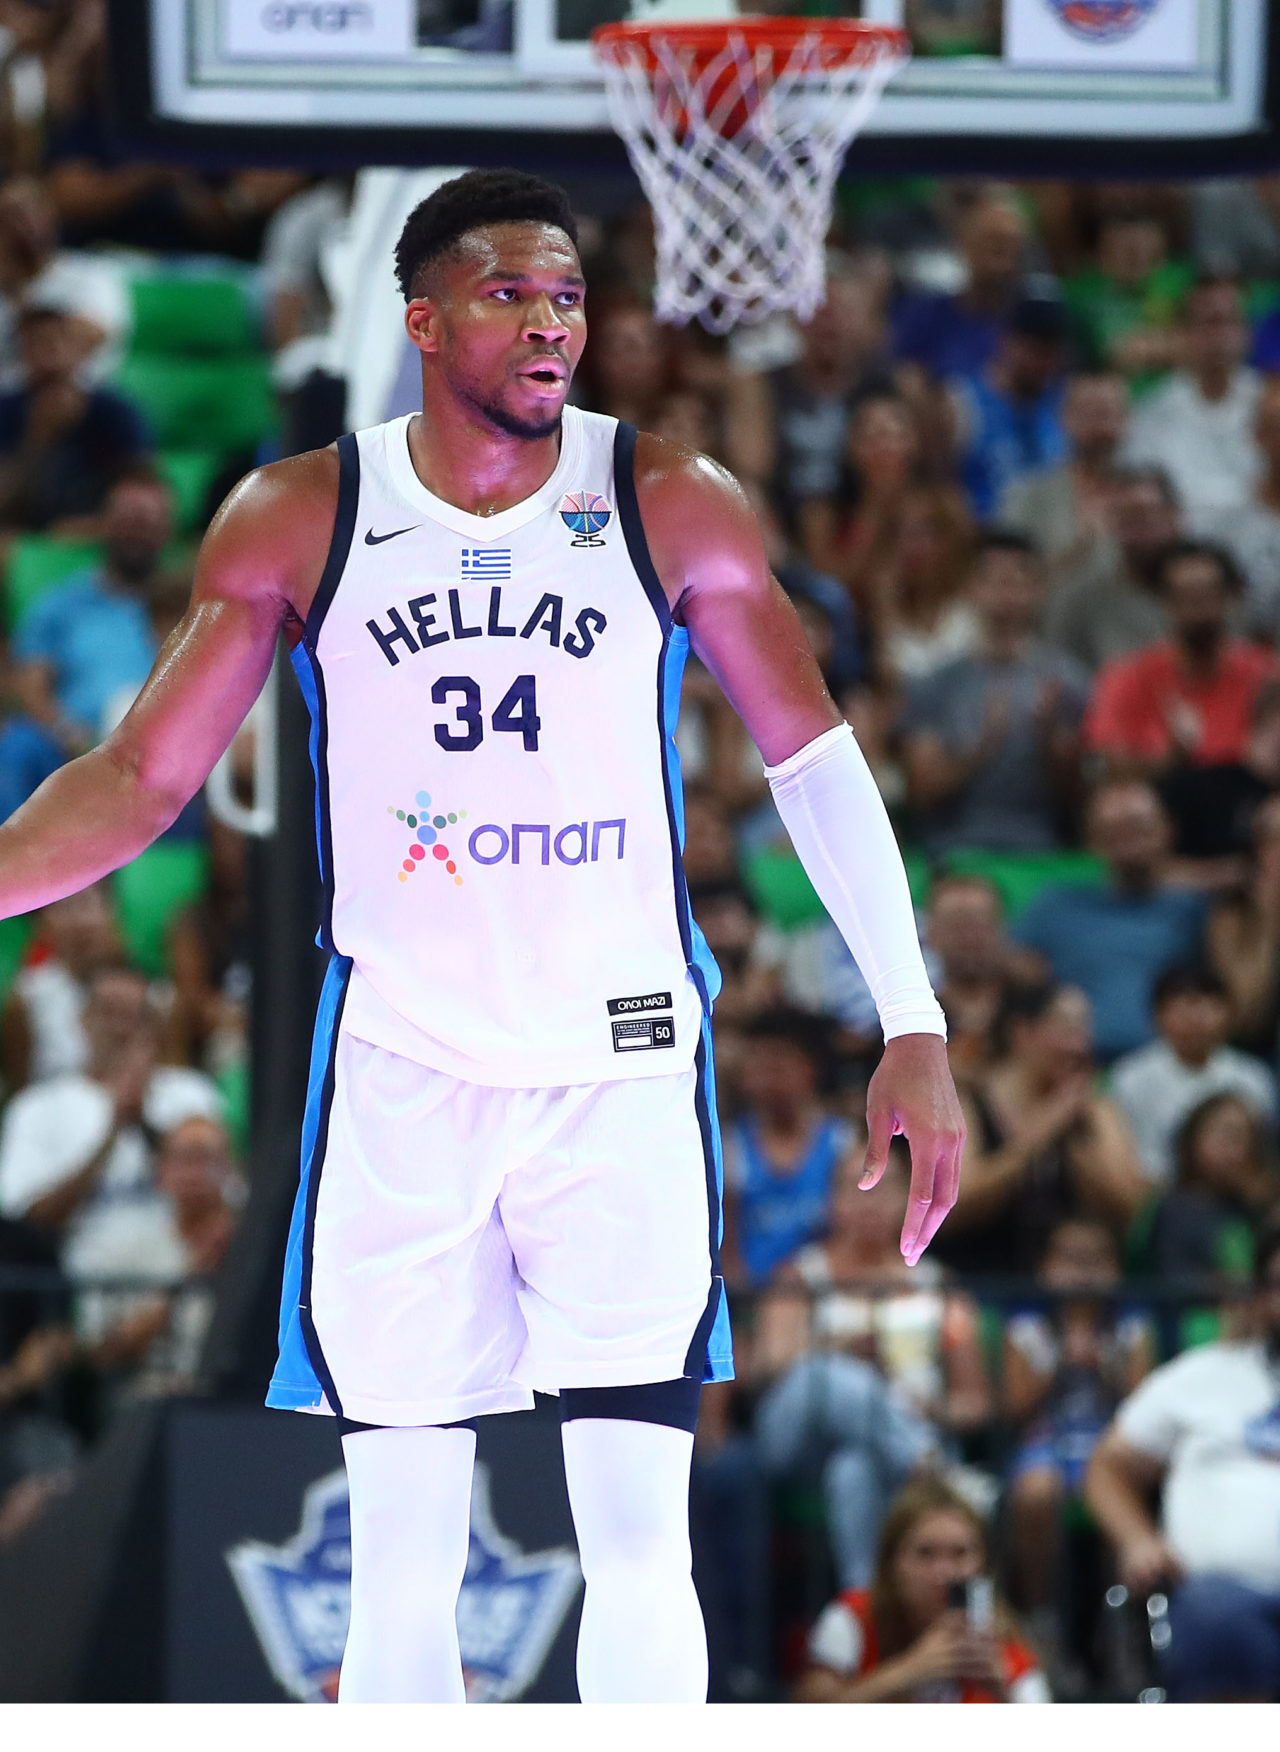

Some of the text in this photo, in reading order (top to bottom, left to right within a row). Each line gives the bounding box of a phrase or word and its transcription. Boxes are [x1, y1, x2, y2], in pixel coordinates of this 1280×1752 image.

[365, 586, 608, 667] HELLAS
[431, 675, 541, 752] 34
[655, 1026, 671, 1039] 50
